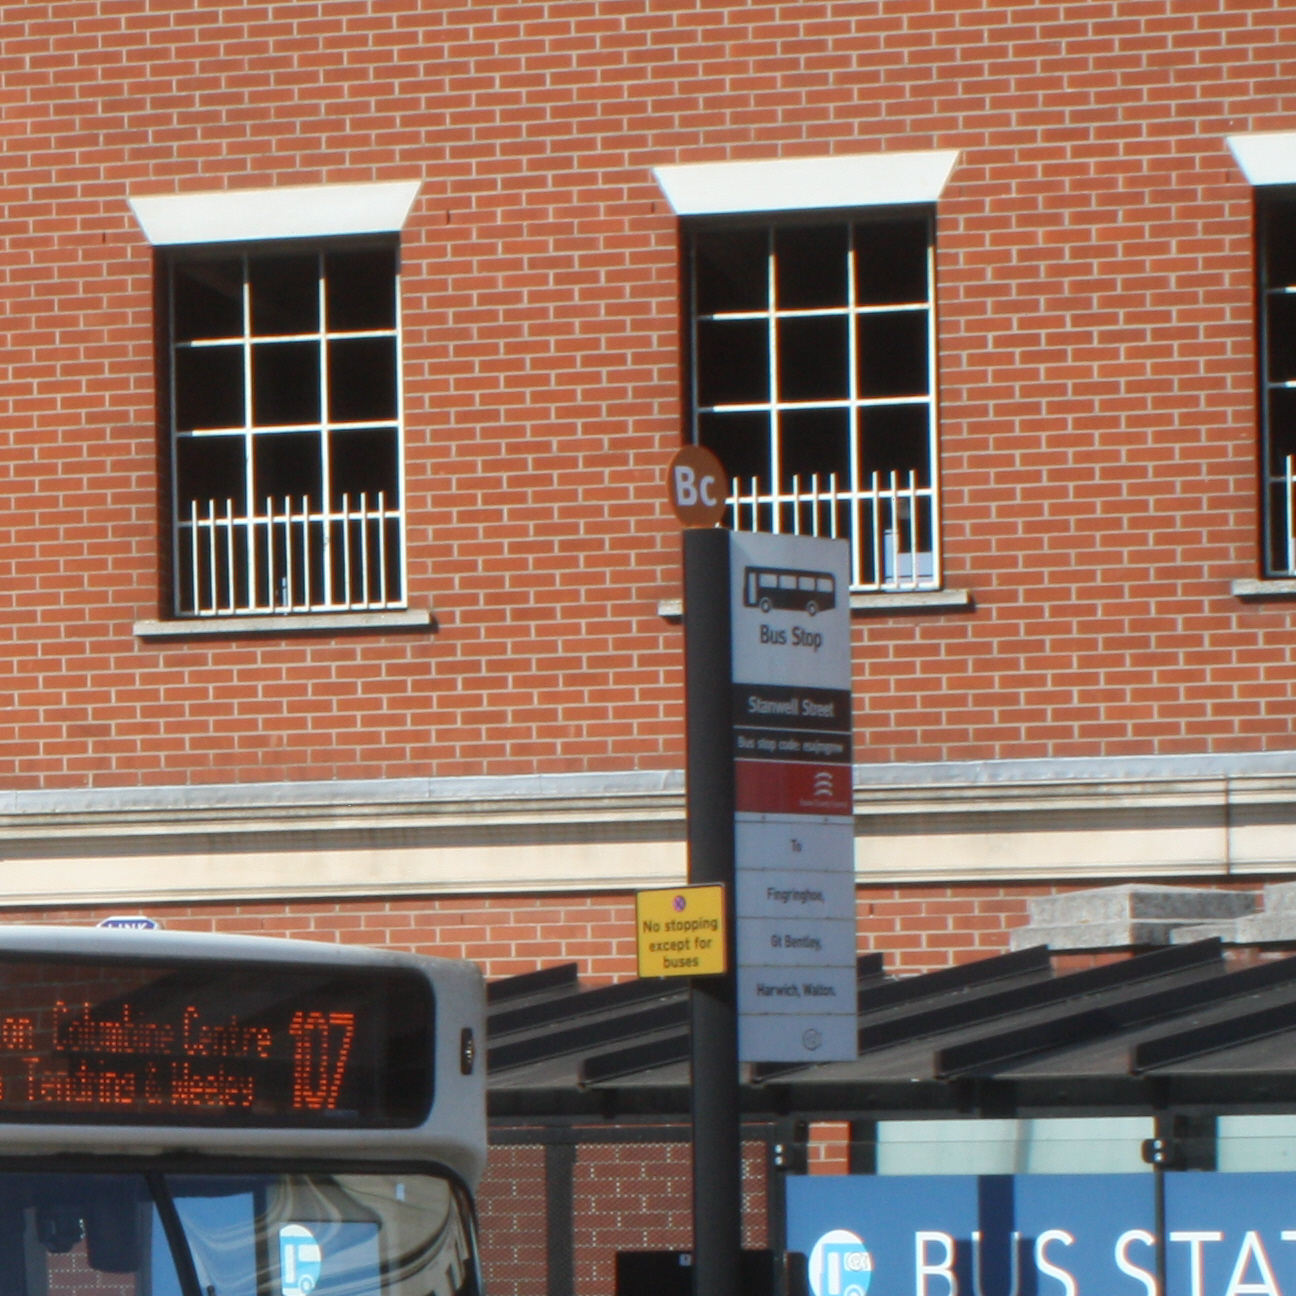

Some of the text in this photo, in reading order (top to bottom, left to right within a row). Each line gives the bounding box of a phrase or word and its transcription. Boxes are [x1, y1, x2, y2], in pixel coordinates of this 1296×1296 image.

[674, 465, 717, 506] Bc
[760, 624, 823, 652] Bus Stop
[748, 696, 835, 718] Stanwell Street
[737, 736, 755, 749] Bus
[756, 738, 777, 752] stop
[790, 838, 802, 852] To
[643, 917, 718, 932] No stopping
[649, 936, 712, 953] except for
[663, 956, 699, 969] buses
[756, 983, 801, 998] Harwich,
[183, 1005, 272, 1058] Centre
[289, 1010, 355, 1110] 107
[172, 1061, 254, 1107] Weeley
